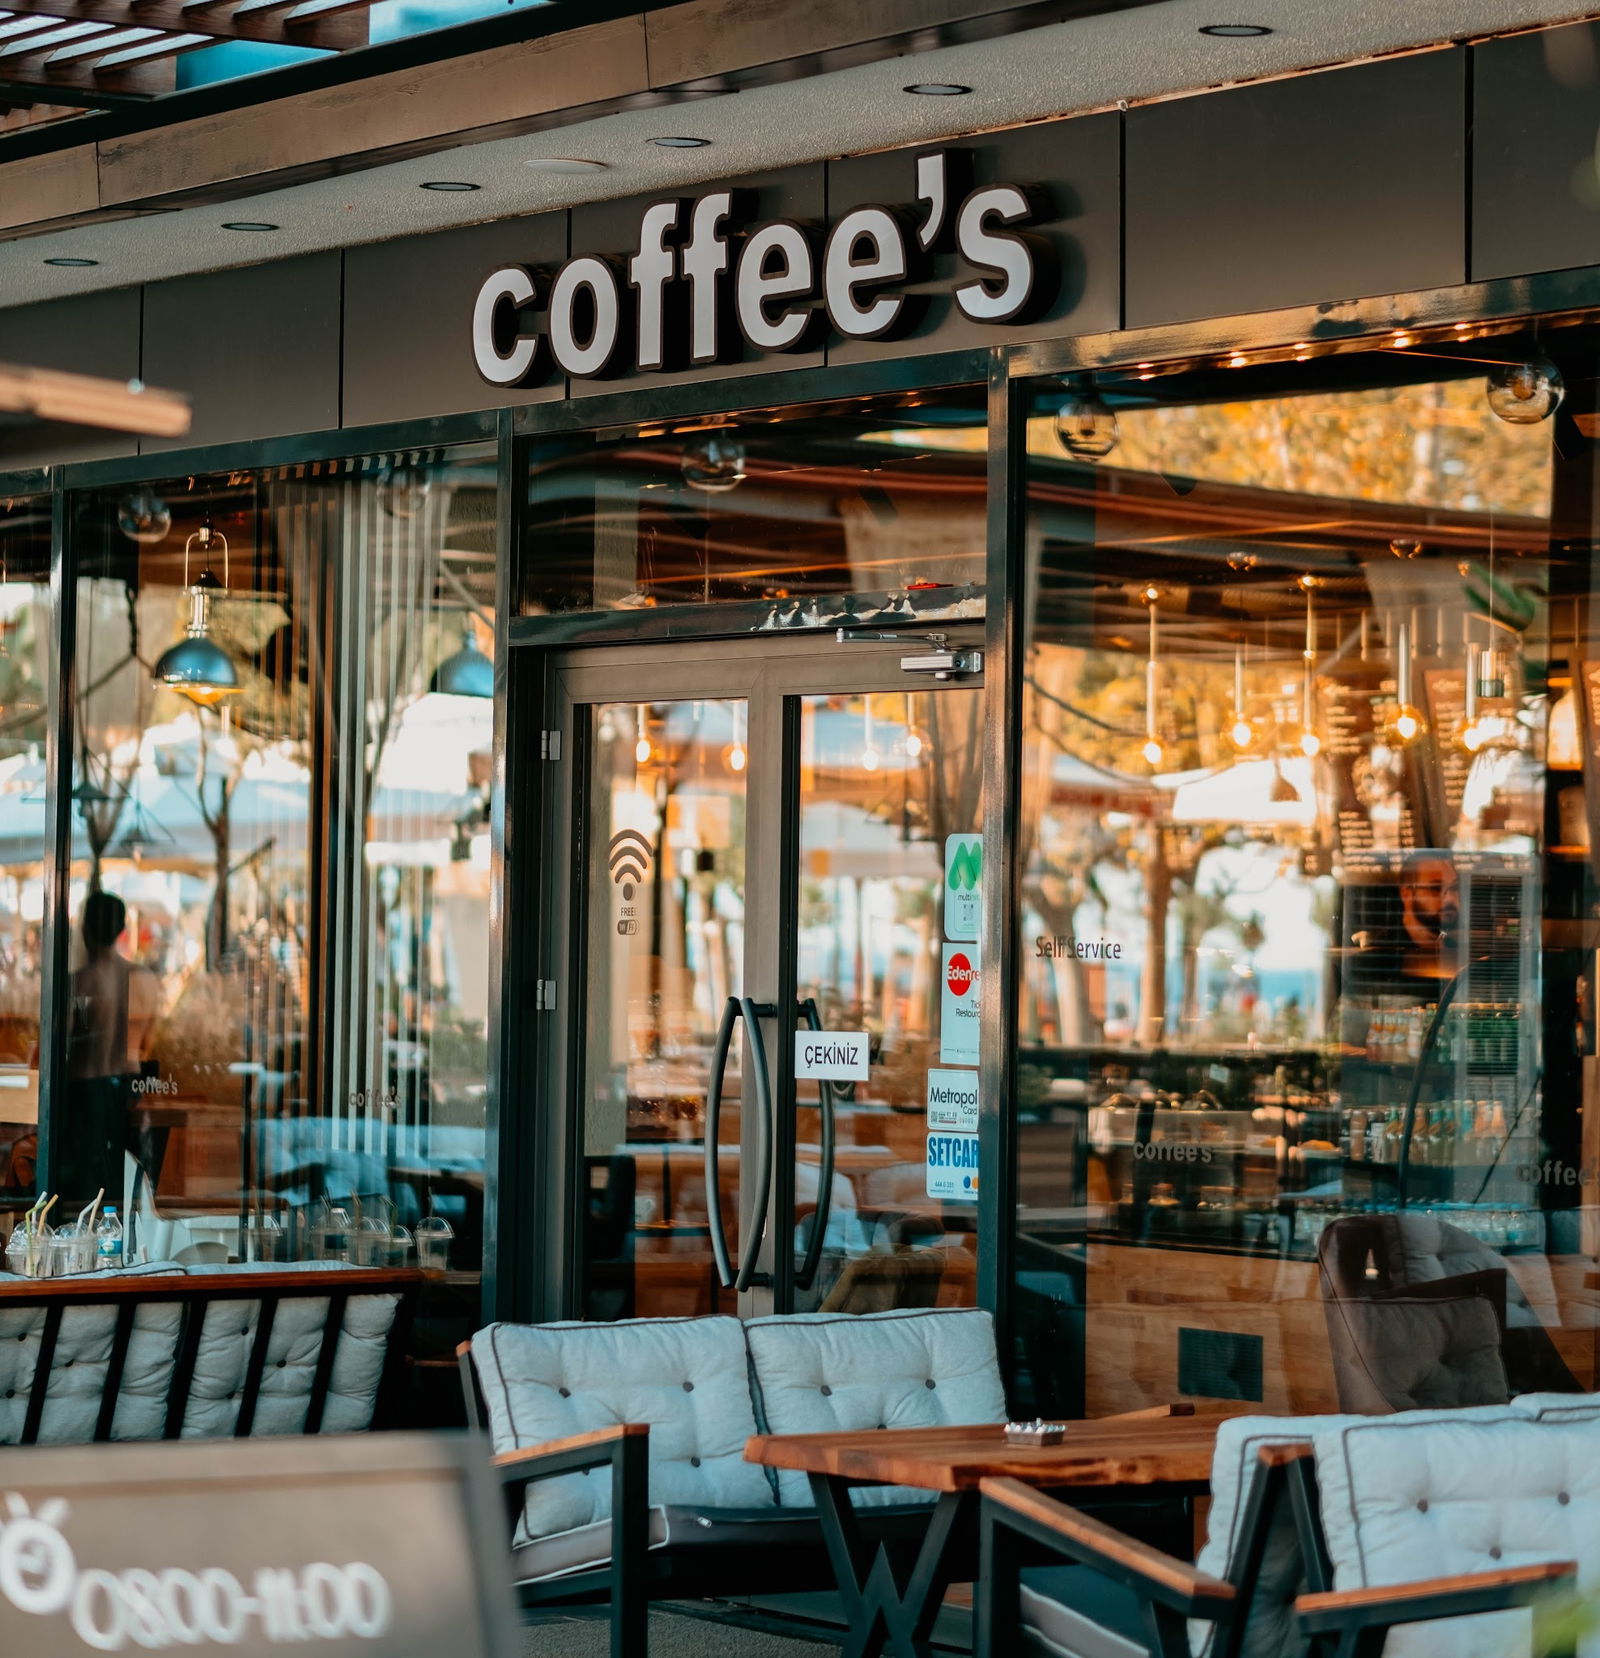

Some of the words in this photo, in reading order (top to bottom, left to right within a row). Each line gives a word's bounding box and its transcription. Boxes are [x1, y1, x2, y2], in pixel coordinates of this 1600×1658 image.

[472, 151, 1034, 386] coffee's
[1036, 936, 1066, 958] Self
[1067, 936, 1121, 959] Service
[805, 1042, 859, 1069] ÇEKİNİZ
[930, 1086, 978, 1108] Metropol
[1516, 1157, 1600, 1187] coffee'
